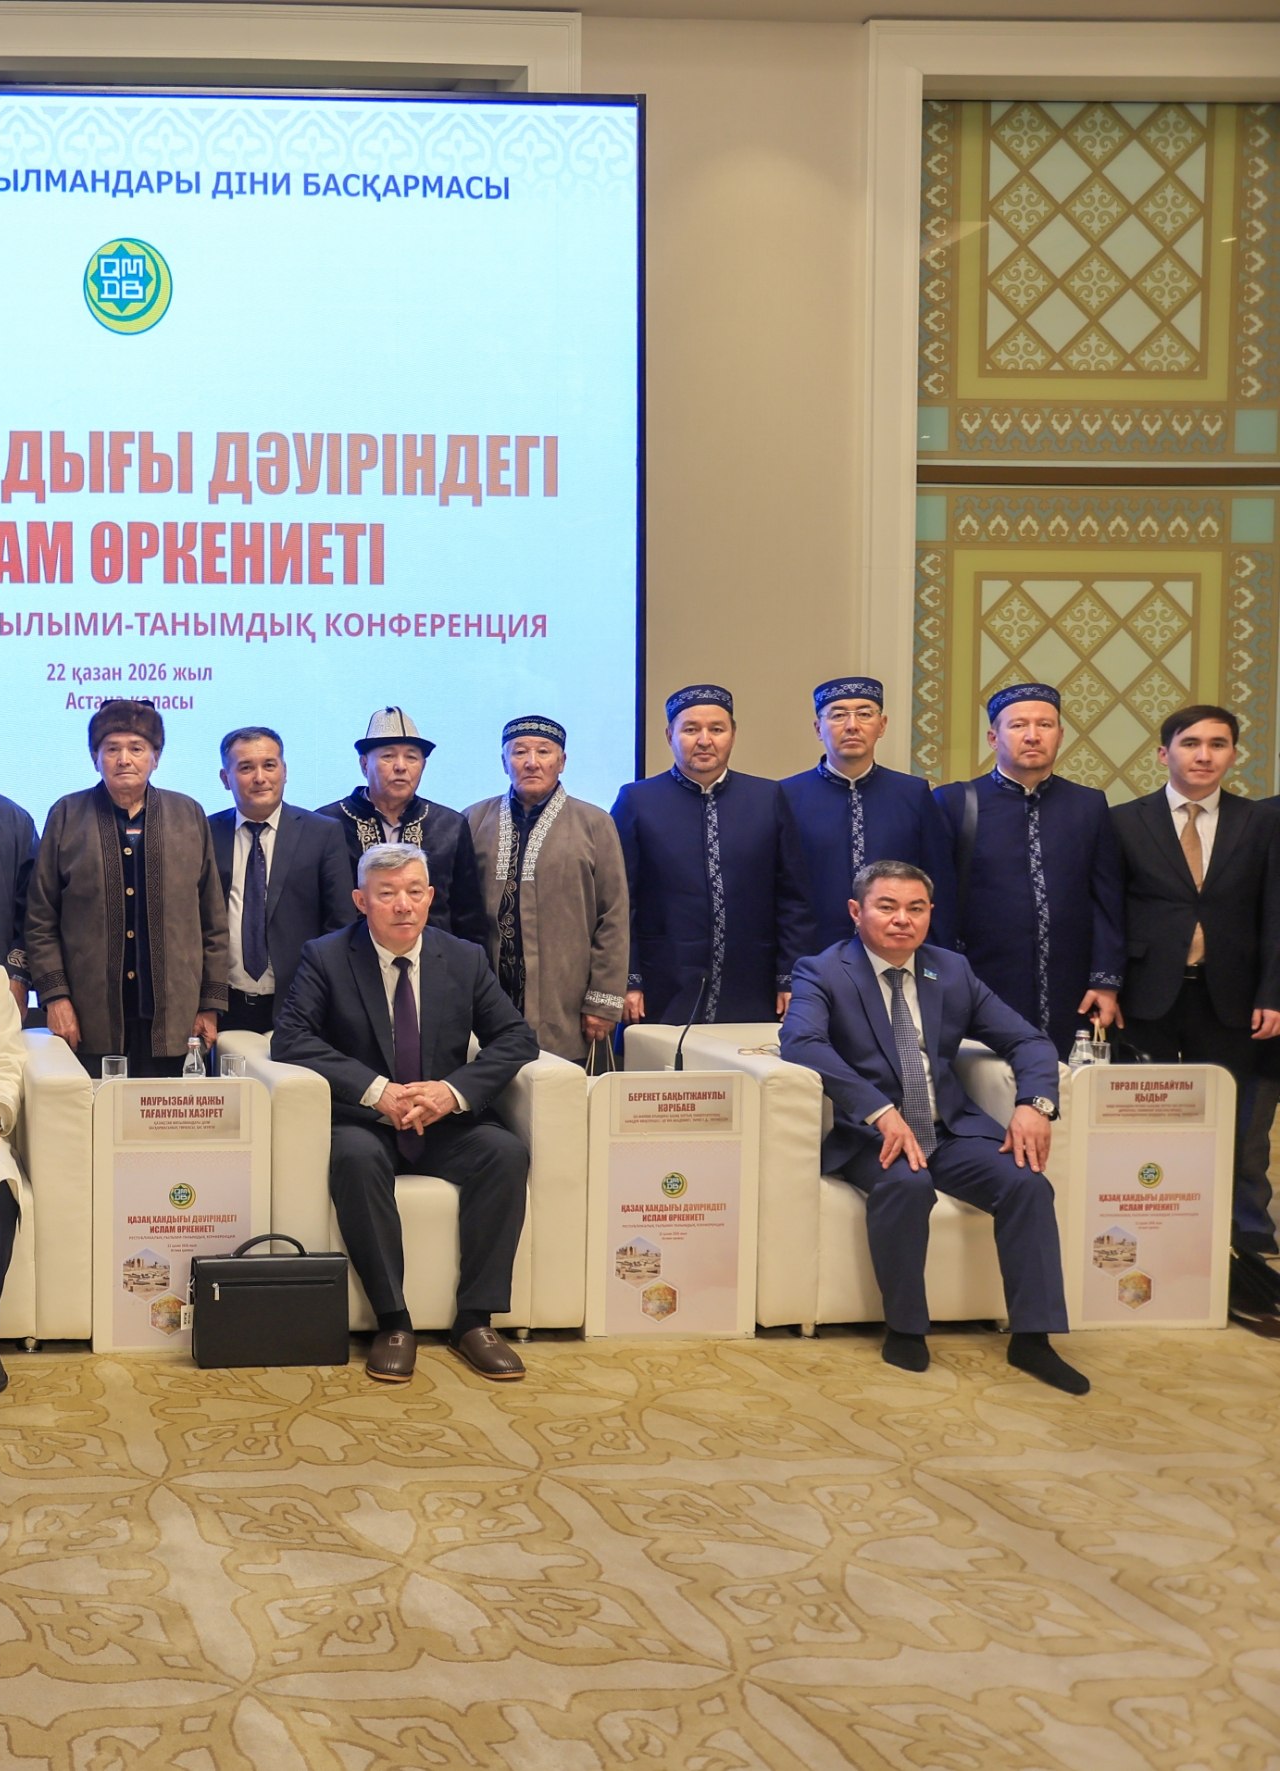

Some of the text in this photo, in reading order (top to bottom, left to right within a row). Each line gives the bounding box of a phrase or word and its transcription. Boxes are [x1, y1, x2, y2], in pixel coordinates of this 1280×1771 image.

[211, 170, 291, 200] ДІНИ
[303, 172, 510, 203] БАСҚАРМАСЫ
[207, 431, 559, 508] ДӘУІРІНДЕГІ
[90, 520, 385, 586] ӨРКЕНИЕТІ
[325, 612, 548, 645] КОНФЕРЕНЦИЯ
[47, 663, 212, 685] 22 қазан 2026 жыл
[140, 1095, 224, 1107] НАУРЫЗБАЙ ҚАЖЫ
[628, 1092, 660, 1102] БЕРЕКЕТ
[189, 1108, 224, 1118] ХАЗІРЕТ
[658, 1103, 696, 1112] КӘРІБАЕВ
[642, 1214, 667, 1222] ИСЛАМ
[150, 1225, 176, 1234] ИСЛАМ
